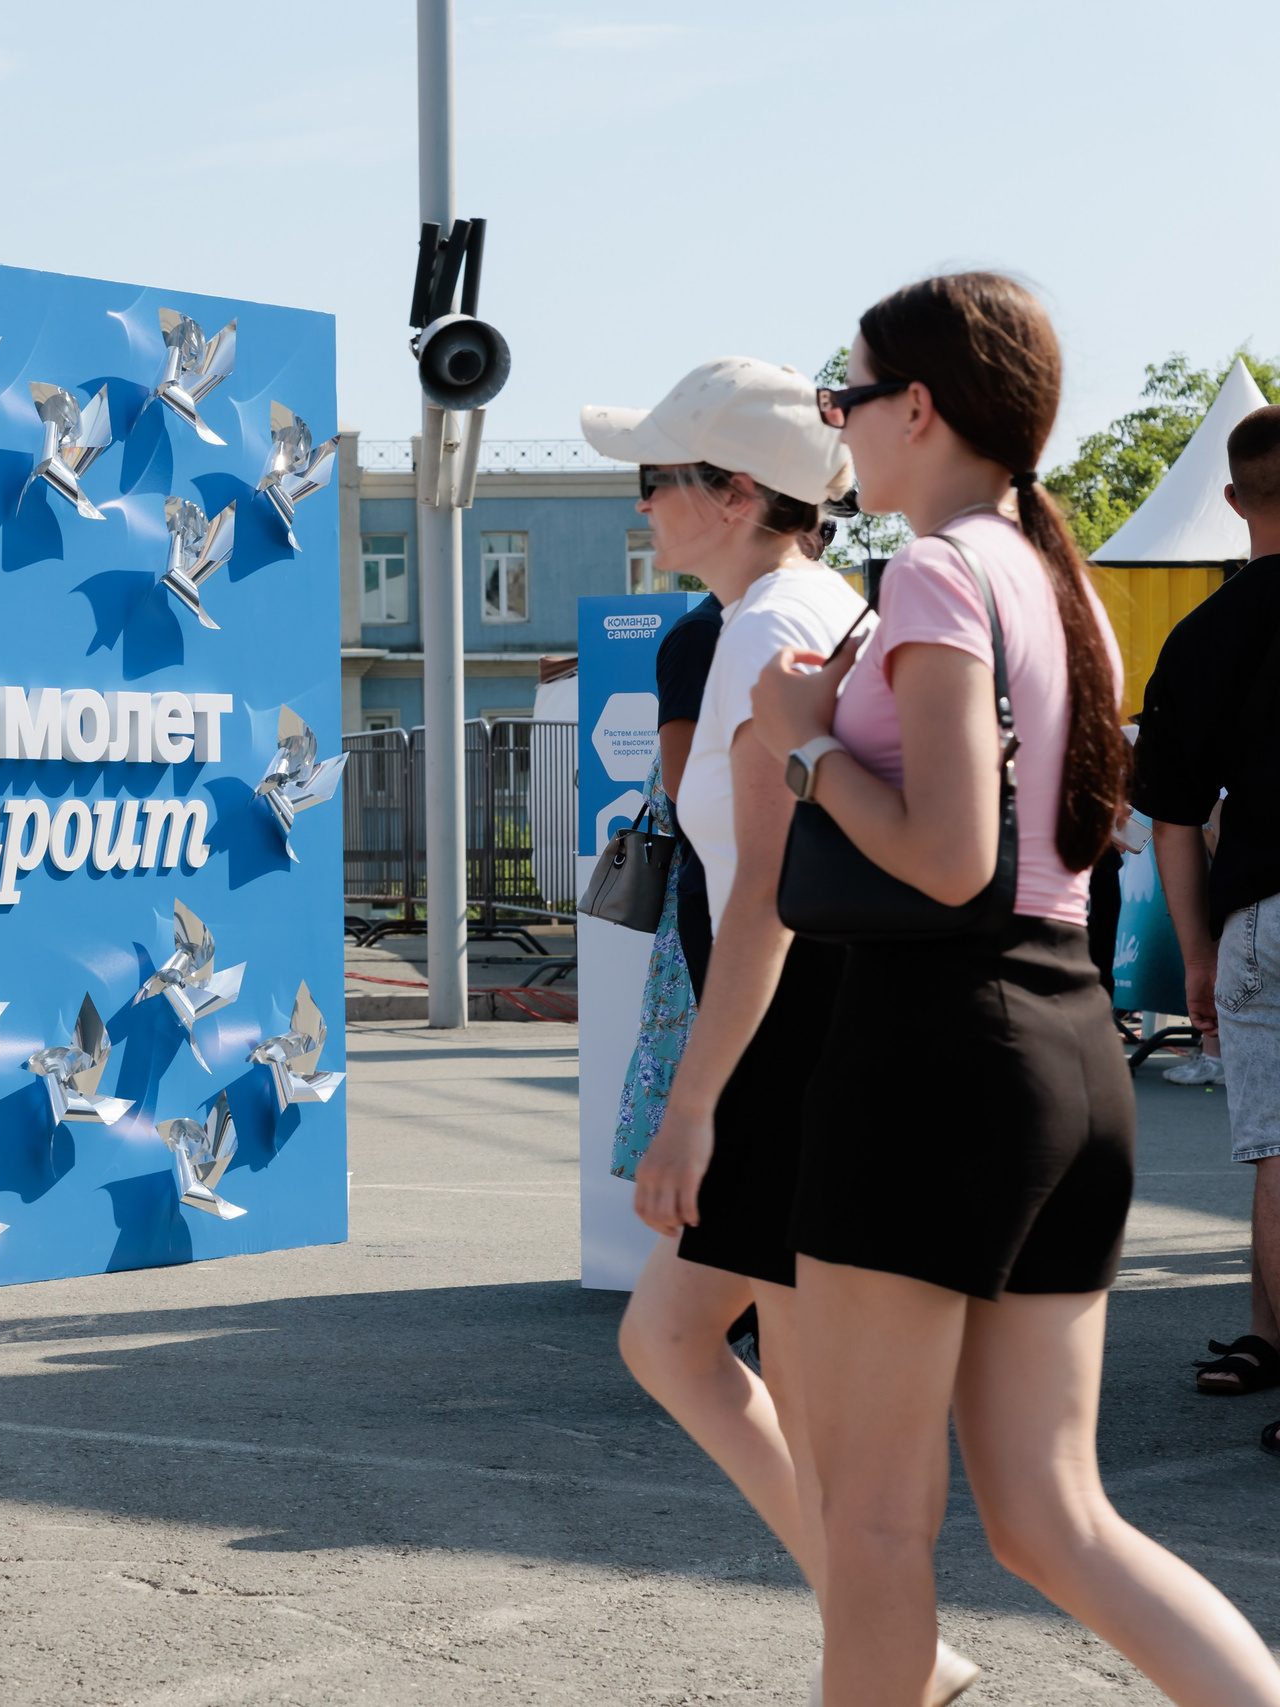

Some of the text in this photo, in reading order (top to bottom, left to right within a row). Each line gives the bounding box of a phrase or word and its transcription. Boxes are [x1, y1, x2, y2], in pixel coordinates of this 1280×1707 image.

[607, 616, 657, 628] команда
[606, 629, 657, 640] самолет
[603, 729, 659, 737] Растем вмест
[611, 739, 655, 747] на высоких
[613, 749, 653, 757] скоростях
